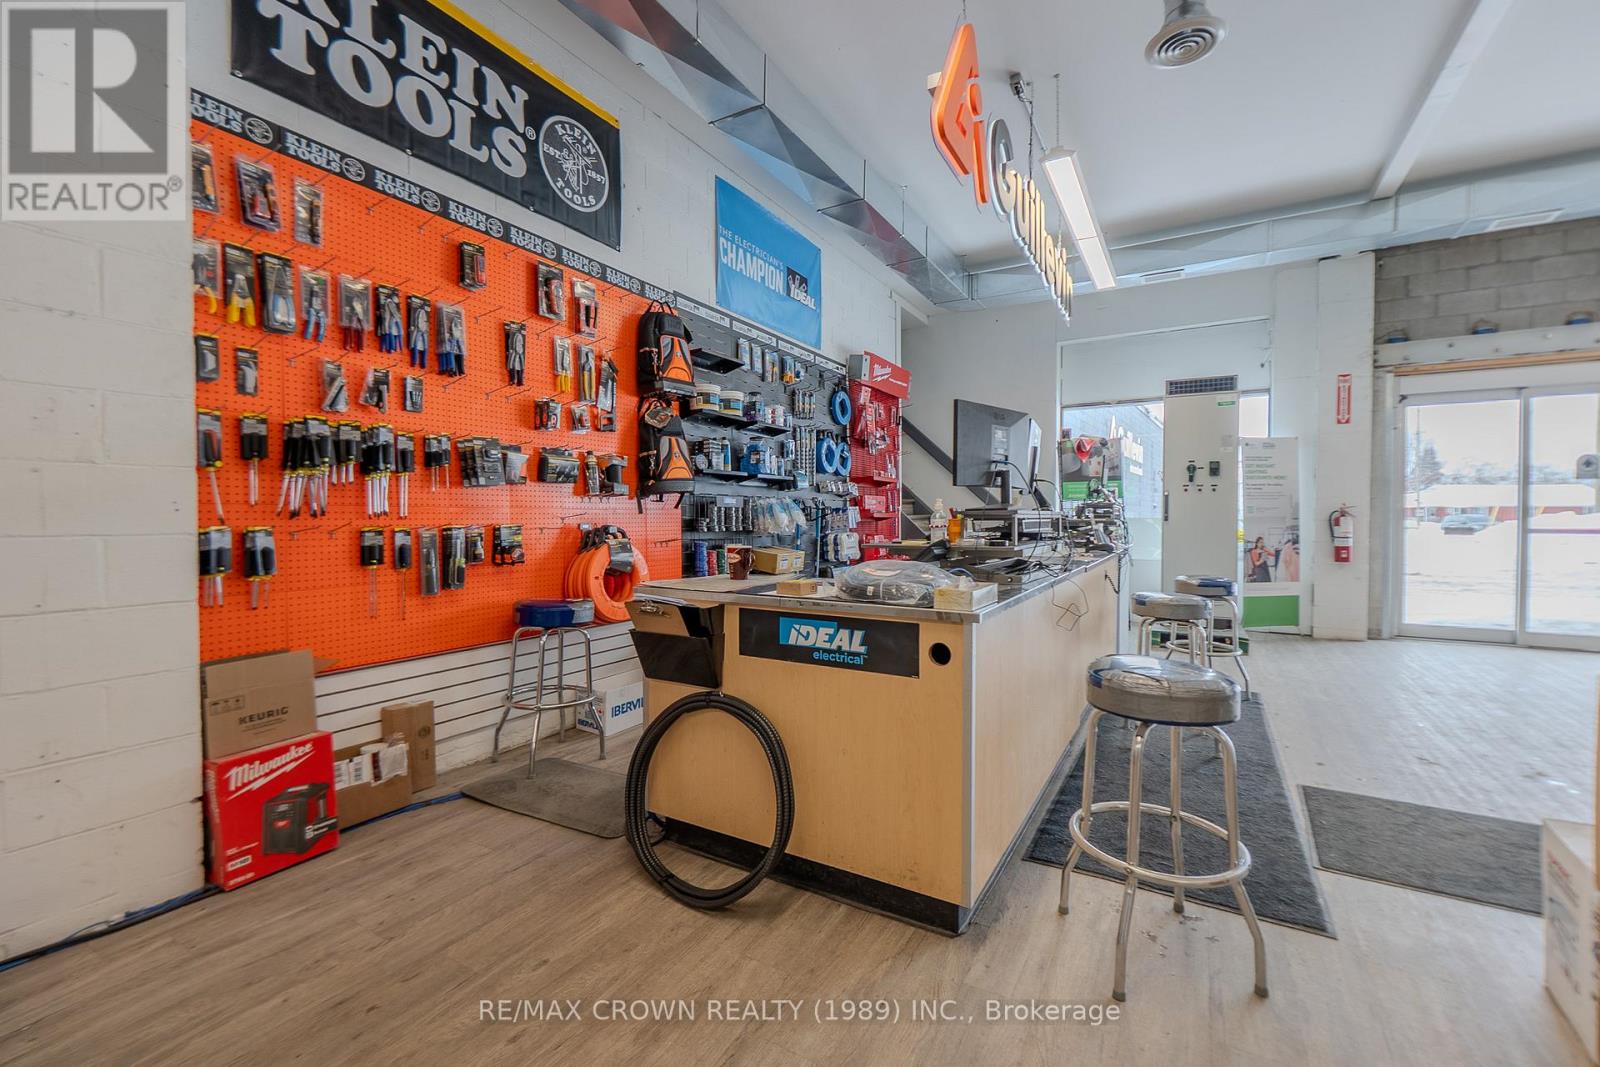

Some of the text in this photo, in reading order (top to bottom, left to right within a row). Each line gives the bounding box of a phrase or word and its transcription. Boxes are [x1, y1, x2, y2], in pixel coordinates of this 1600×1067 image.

[285, 0, 529, 133] LEIN
[191, 93, 244, 125] LEIN
[191, 104, 243, 133] OOLS
[285, 131, 342, 165] KLEIN
[555, 123, 597, 155] KLEIN
[285, 143, 341, 173] TOOLS
[374, 169, 421, 194] KLEIN
[375, 179, 421, 205] TOOLS
[556, 177, 596, 207] TOOLS
[448, 200, 487, 223] KLEIN
[449, 211, 487, 232] TOOLS
[510, 226, 542, 246] KLEIN
[510, 234, 542, 254] TOOLS
[719, 225, 733, 240] THE
[562, 248, 590, 263] KLEIN
[562, 255, 589, 273] TOOLS
[606, 267, 630, 282] KLEIN
[606, 275, 630, 289] TOOLS
[239, 706, 289, 725] KEURIG
